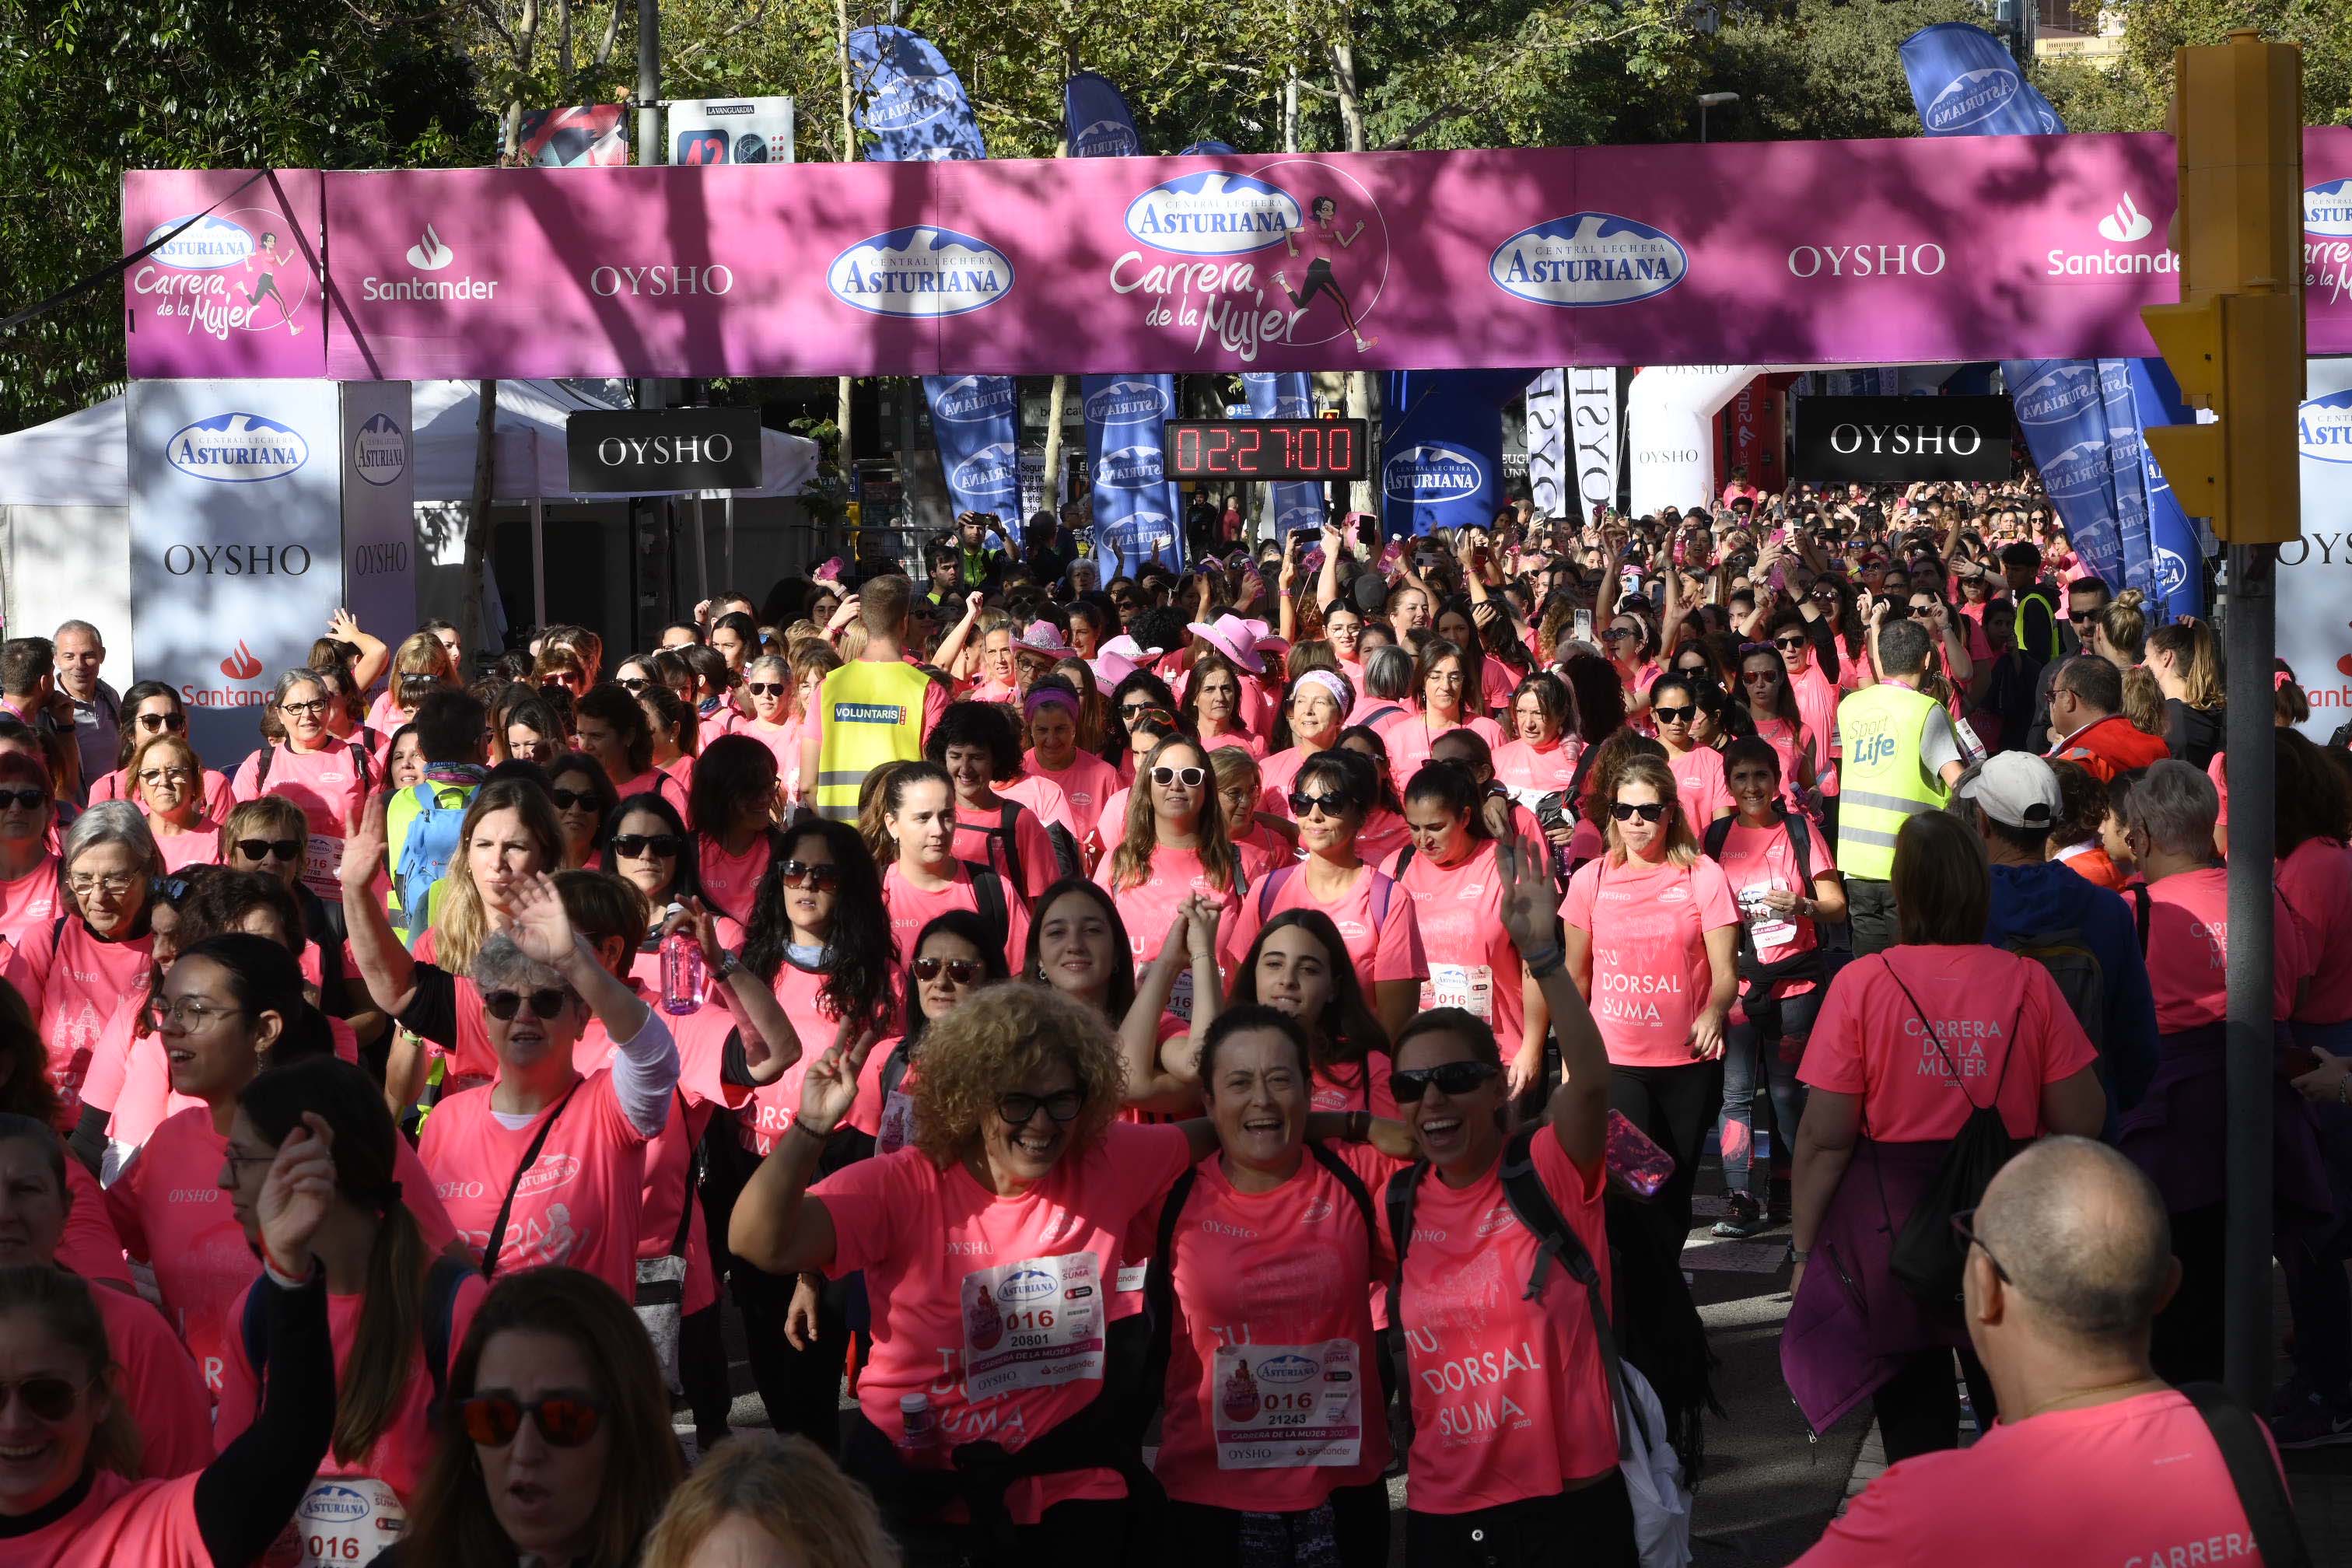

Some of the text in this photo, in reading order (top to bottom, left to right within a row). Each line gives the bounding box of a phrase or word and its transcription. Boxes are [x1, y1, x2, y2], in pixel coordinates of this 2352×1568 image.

[1164, 198, 1283, 208] CENTRAL LECHERA
[1139, 203, 1288, 234] ASTURIANA
[154, 234, 245, 255] ASTURIANA
[1535, 243, 1665, 255] CENTRAL LECHERA
[871, 257, 993, 266] CENTRAL LECHERA
[1505, 249, 1671, 284] ASTURIANA
[1788, 243, 1945, 278] OYSHO
[135, 266, 226, 294] Carrera
[590, 264, 733, 296] OYSHO
[842, 261, 1000, 293] ASTURIANA
[1110, 251, 1256, 294] Carrera
[2319, 264, 2333, 286] la
[362, 276, 498, 301] Santander
[156, 293, 261, 341] de la Mujer
[1145, 290, 1310, 362] de la Mujer
[1830, 423, 1981, 455] OYSHO
[177, 438, 299, 465] ASTURIANA
[359, 440, 404, 467] ASTURIANA
[598, 434, 733, 466] OYSHO
[1177, 429, 1351, 471] 02:27:00
[1639, 449, 1699, 464] OYSHO
[1386, 470, 1474, 490] ASTURIANA
[164, 544, 311, 576] OYSHO
[356, 542, 407, 576] OYSHO
[2302, 684, 2352, 708] ant
[835, 707, 898, 719] VOLUNTARIS
[1850, 716, 1888, 740] Sport
[1853, 733, 1895, 765] Life
[704, 880, 727, 889] SHO
[1410, 891, 1433, 901] SHO
[1598, 891, 1631, 901] OYSHO
[891, 919, 919, 928] SHO
[1602, 973, 1681, 994] DORSAL
[1439, 994, 1466, 1005] 016
[1602, 997, 1660, 1020] SUMA
[1905, 1018, 2002, 1038] CARRERA
[1923, 1039, 1984, 1057] DE LA
[1917, 1059, 1988, 1077] MUJER
[516, 1165, 576, 1190] STURIANA
[168, 1188, 218, 1202] OYSHO
[1202, 1220, 1258, 1238] OYSHO
[1062, 1270, 1090, 1280] SUMA
[1002, 1283, 1054, 1298] ASTURIANA
[1007, 1310, 1055, 1331] 016
[1011, 1334, 1049, 1346] 20801
[1405, 1326, 1439, 1359] TU
[979, 1356, 1014, 1370] CARRERA
[1041, 1347, 1071, 1357] MUJER
[1052, 1358, 1095, 1374] Santander
[1325, 1354, 1350, 1364] SUMA
[1421, 1342, 1542, 1393] DORSAL
[978, 1371, 1017, 1391] OYSHO
[1262, 1363, 1314, 1378] ASTURIANA
[1264, 1391, 1312, 1409] 016
[940, 1405, 1025, 1433] UMA
[1268, 1414, 1307, 1425] 21243
[1438, 1395, 1524, 1436] SUMA
[1231, 1430, 1269, 1440] CARRERA
[1272, 1430, 1282, 1440] DE
[1284, 1430, 1295, 1439] LA
[1297, 1430, 1327, 1439] MUJER
[1228, 1447, 1271, 1459] OYSHO
[1306, 1445, 1351, 1457] Santander
[303, 1498, 364, 1515] ASTURIANA
[308, 1534, 359, 1559] 016
